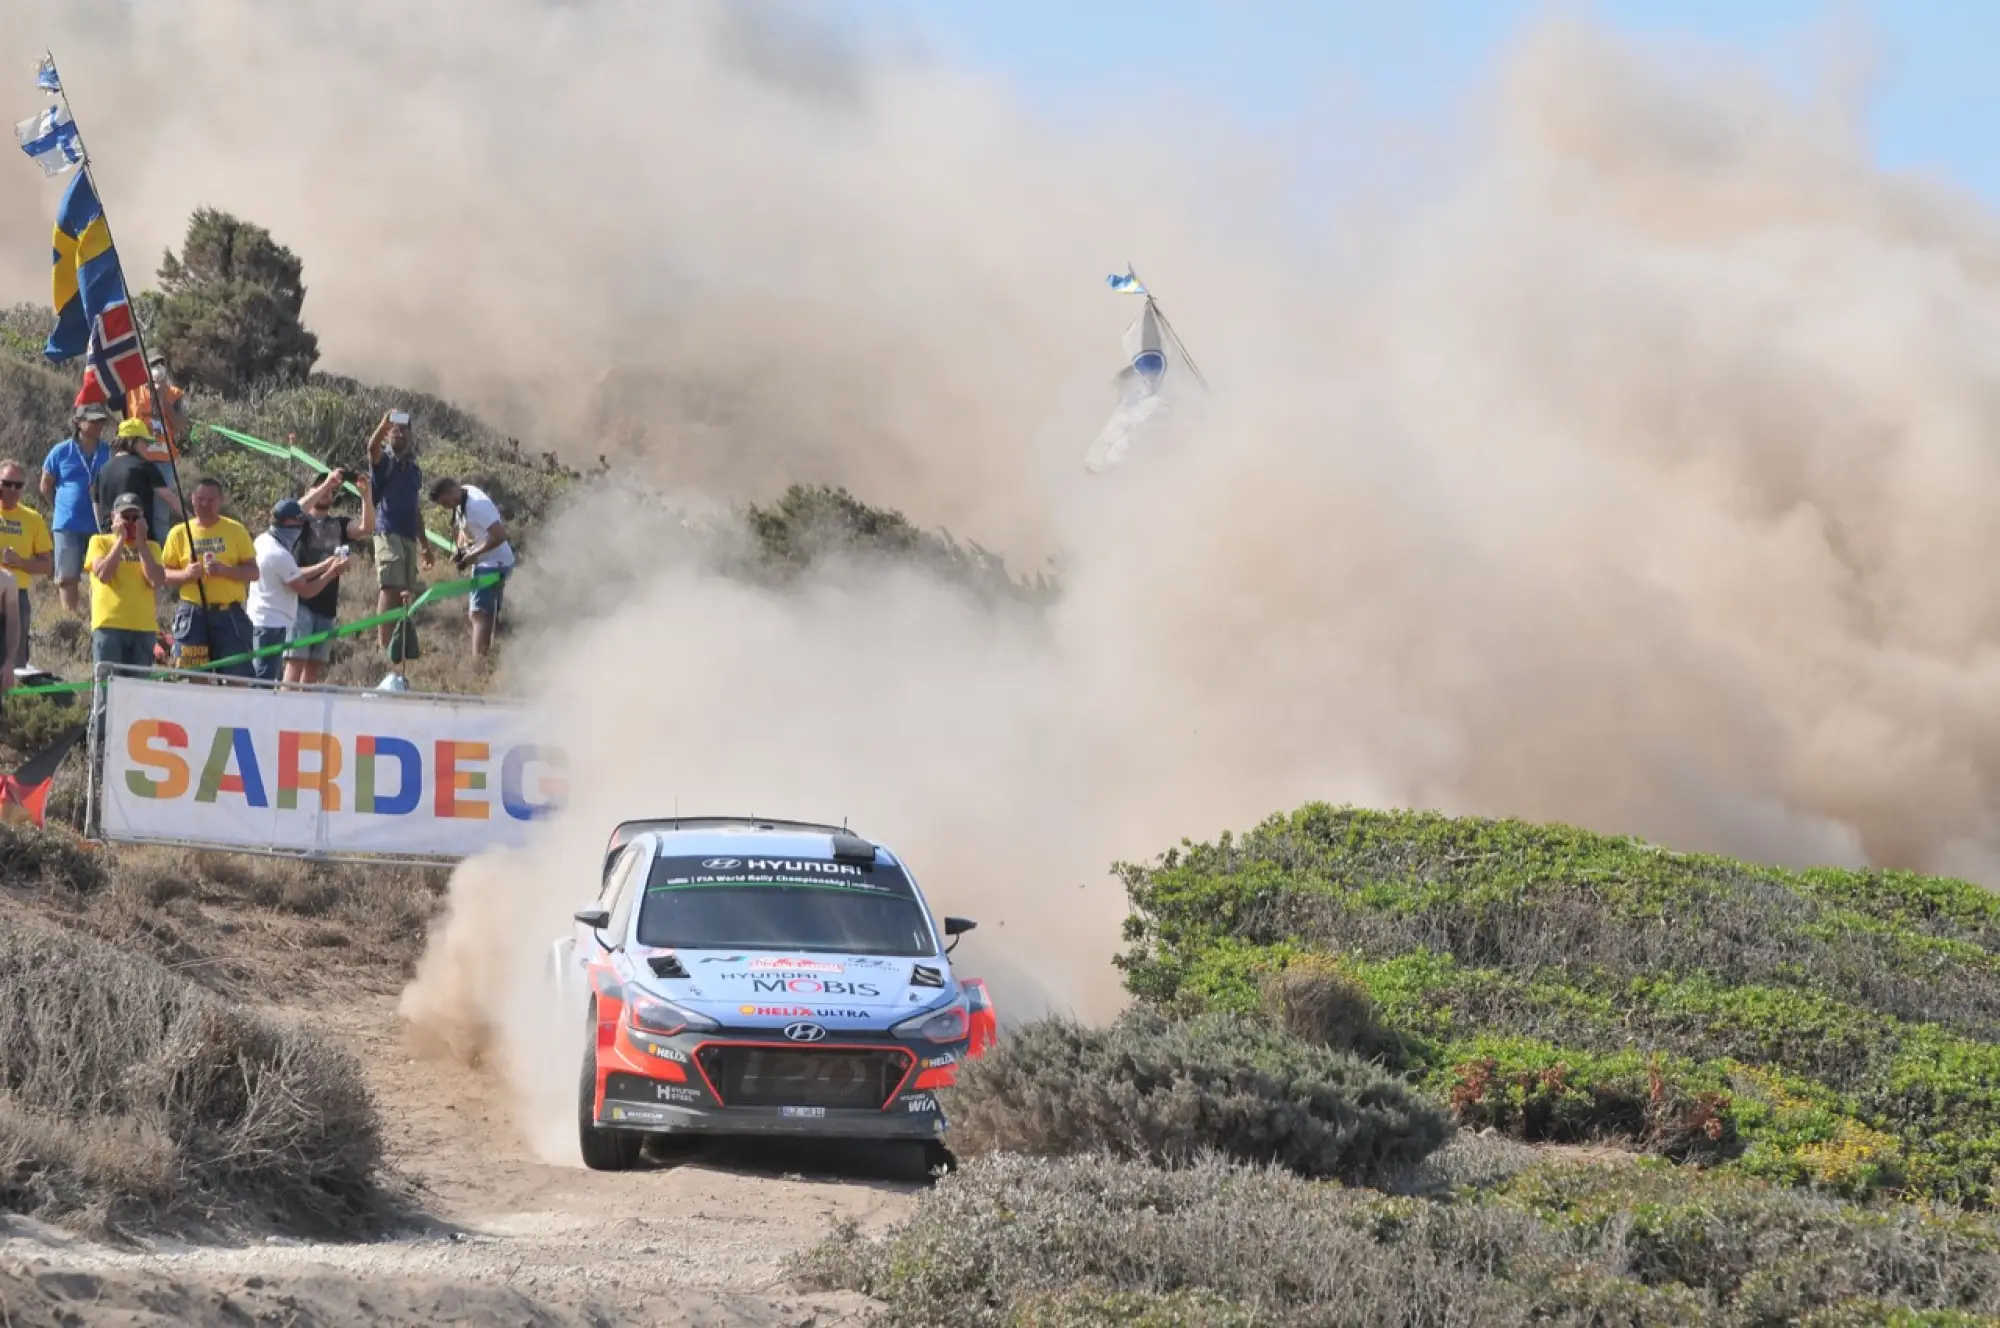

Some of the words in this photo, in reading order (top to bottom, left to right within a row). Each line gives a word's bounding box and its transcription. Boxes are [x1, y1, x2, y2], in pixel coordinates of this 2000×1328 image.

[748, 860, 862, 876] HYUNDAI
[747, 875, 773, 883] Rally
[776, 875, 845, 887] Championship
[721, 972, 818, 980] HYUNDAI
[754, 979, 881, 997] MOBIS
[757, 1006, 814, 1017] HELIX
[816, 1007, 871, 1018] ULTRA
[657, 1046, 688, 1063] HELIX
[929, 1052, 955, 1068] HELIX
